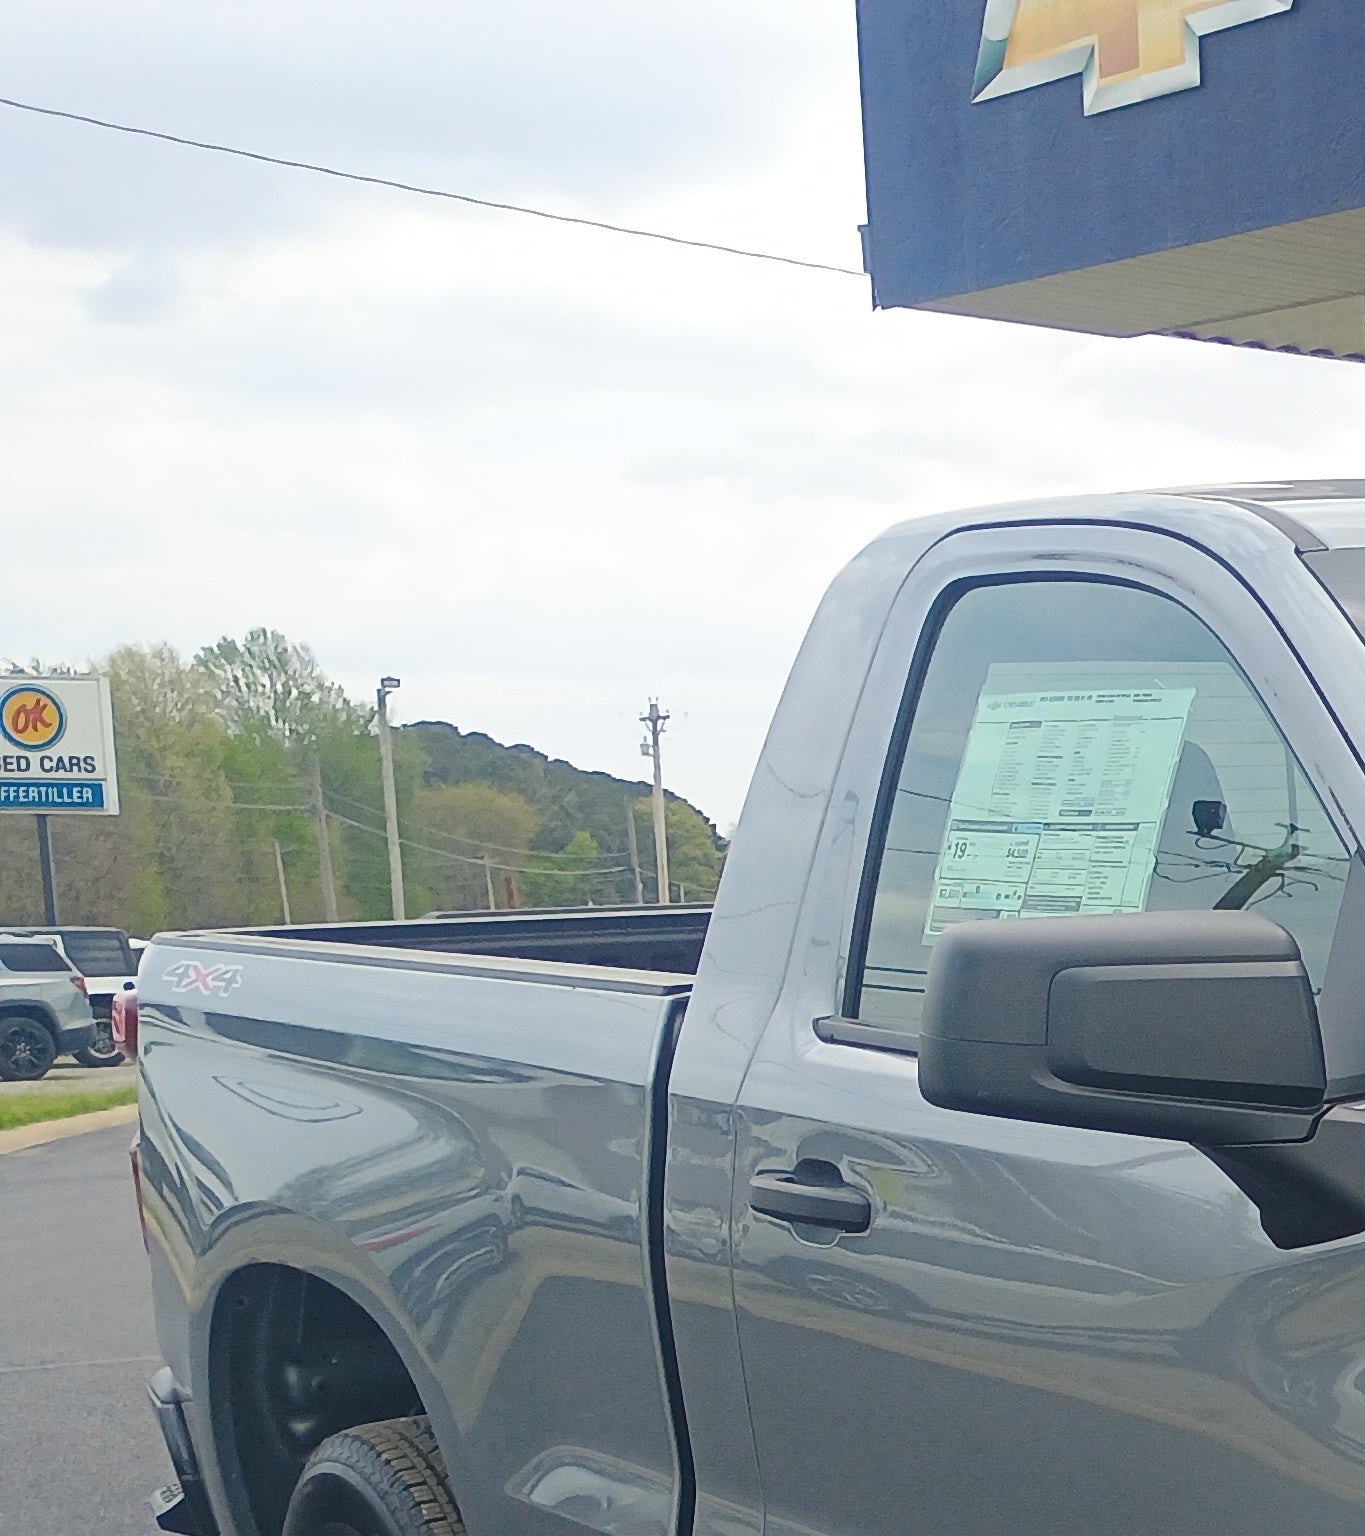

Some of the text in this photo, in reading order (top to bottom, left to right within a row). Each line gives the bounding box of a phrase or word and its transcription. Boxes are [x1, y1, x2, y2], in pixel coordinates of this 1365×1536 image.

[11, 697, 53, 735] OK
[0, 755, 97, 774] ED CARS
